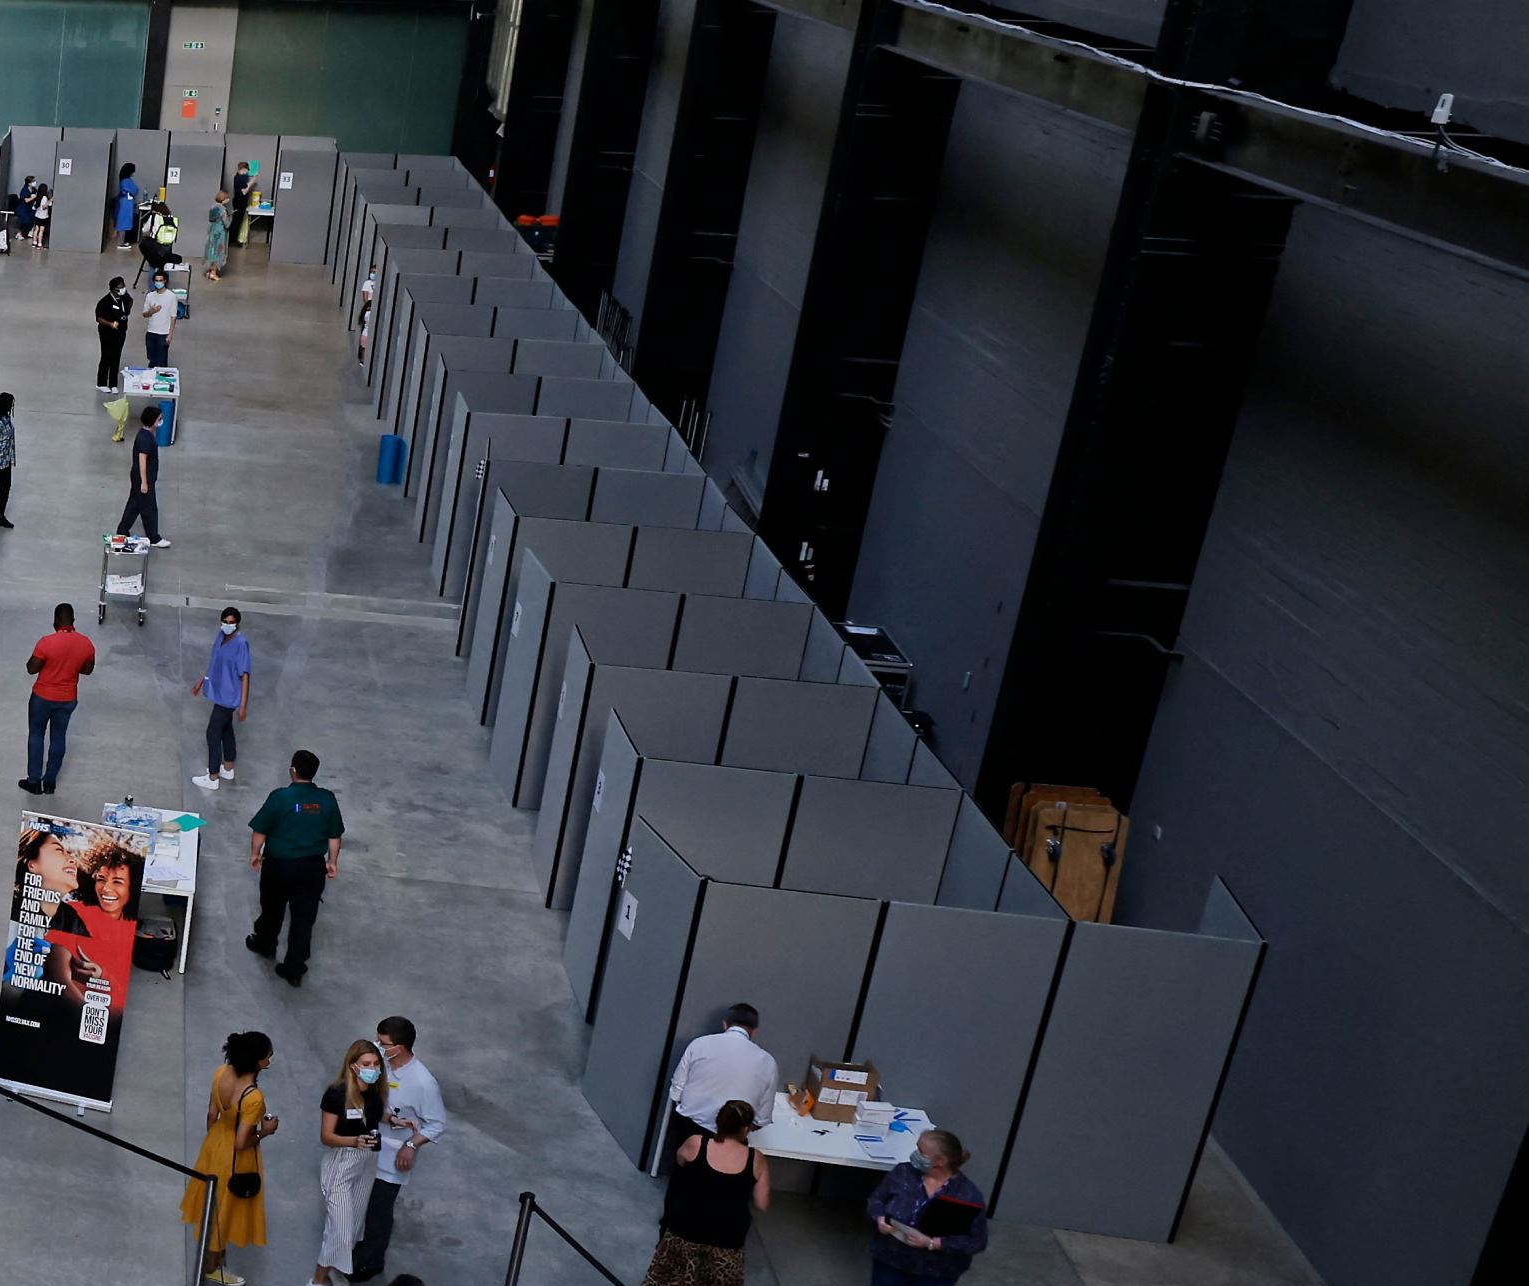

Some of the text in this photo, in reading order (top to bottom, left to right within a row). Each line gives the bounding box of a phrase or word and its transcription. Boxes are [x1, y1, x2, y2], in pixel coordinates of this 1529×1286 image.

[29, 821, 50, 832] NHS
[24, 872, 42, 888] FOR
[22, 885, 61, 904] FRIENDS
[20, 899, 40, 913] AND
[17, 924, 36, 938] FOR
[16, 936, 34, 951] THE
[14, 949, 47, 966] END OF
[86, 993, 100, 1002] OVER
[84, 1014, 105, 1028] MISS
[83, 1024, 103, 1037] YOUR
